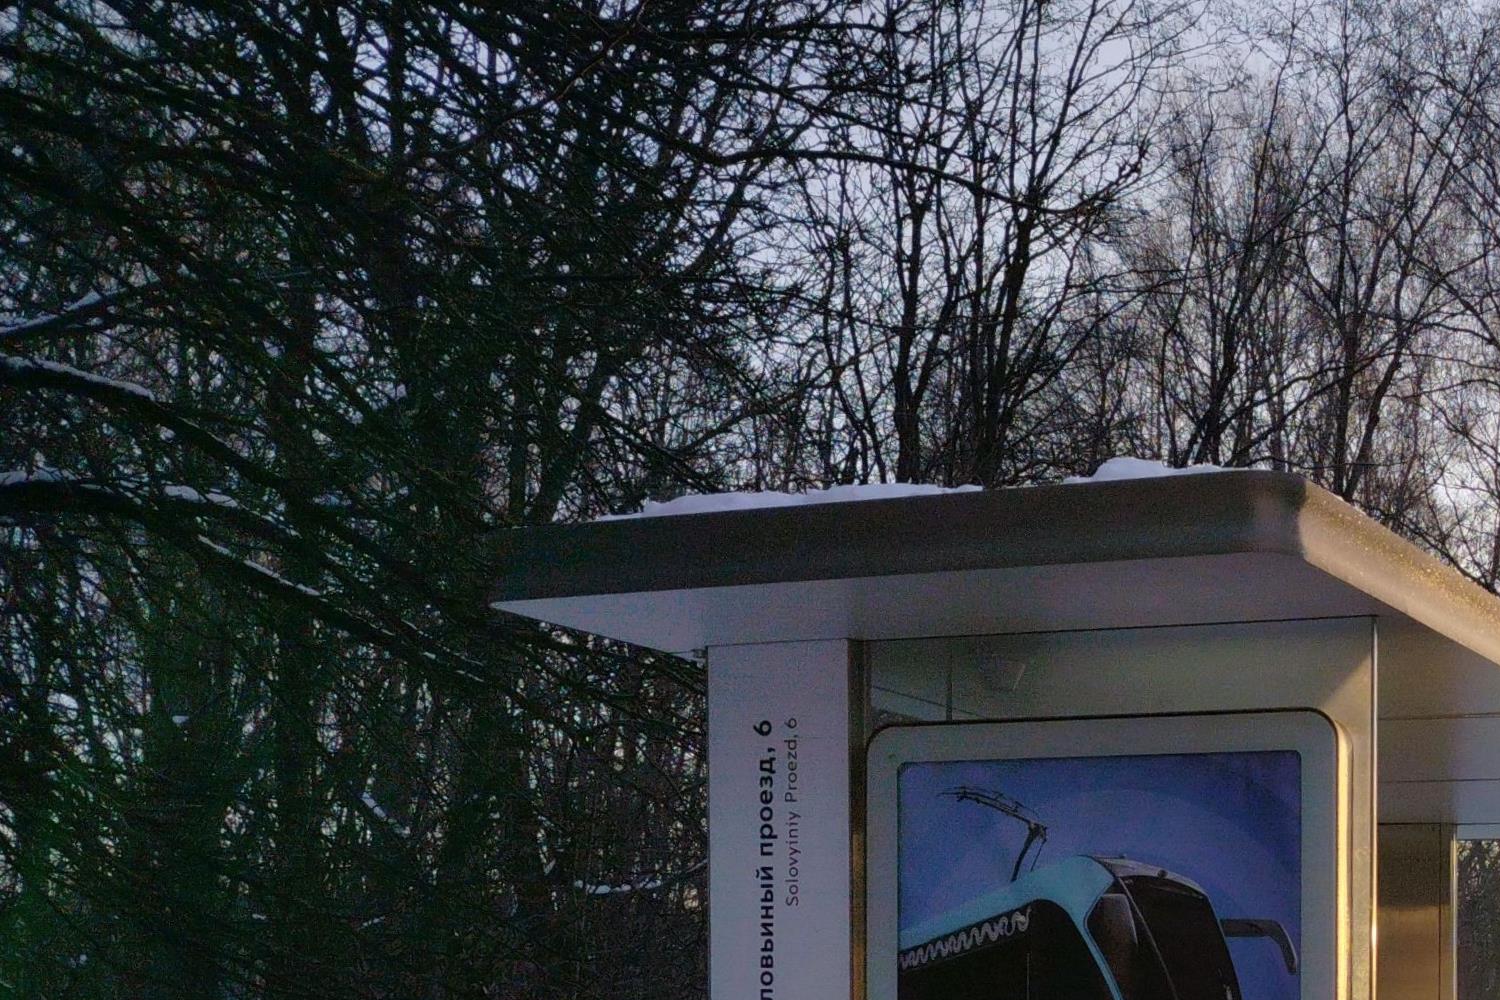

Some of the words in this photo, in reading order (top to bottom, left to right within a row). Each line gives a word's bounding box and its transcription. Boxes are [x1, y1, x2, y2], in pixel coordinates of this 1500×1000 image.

[753, 720, 772, 737] 6
[784, 717, 798, 729] 6
[759, 747, 778, 857] проезд,
[785, 811, 801, 907] Solovyiniy
